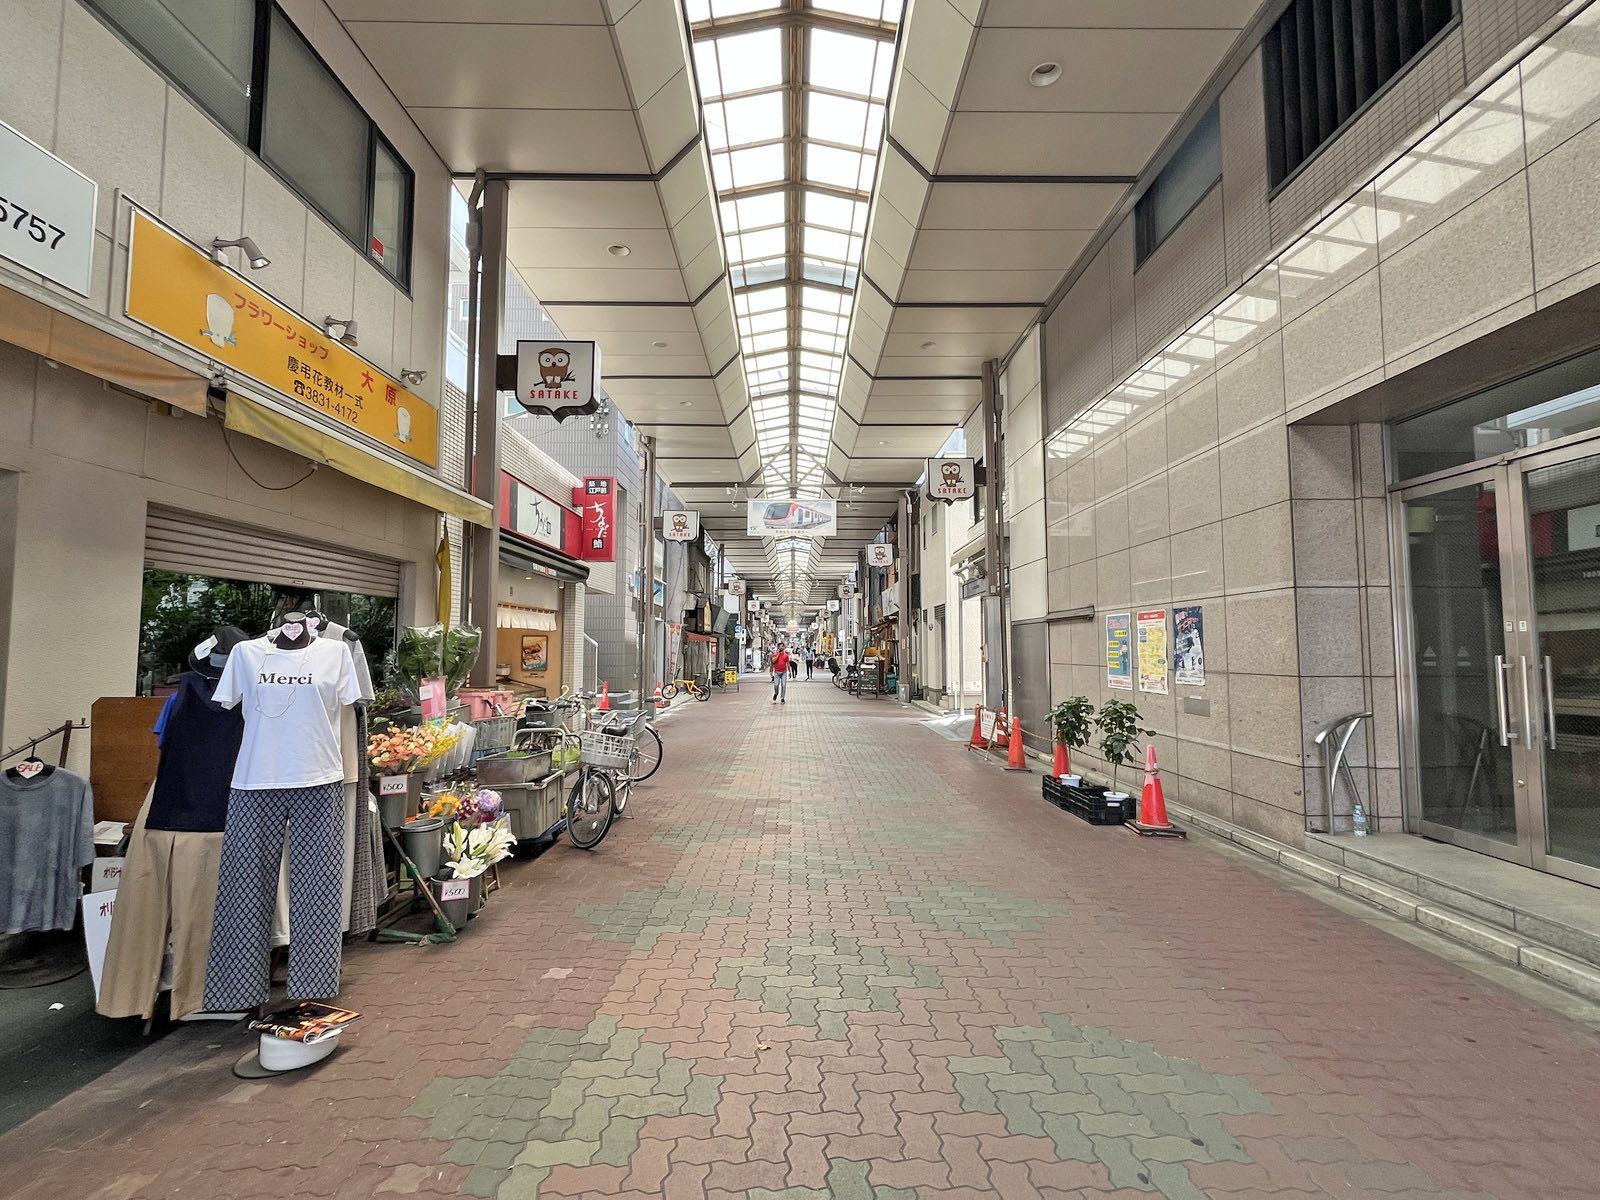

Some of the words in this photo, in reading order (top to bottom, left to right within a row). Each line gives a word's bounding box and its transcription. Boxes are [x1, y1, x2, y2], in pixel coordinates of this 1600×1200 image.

[234, 292, 329, 360] フラワーショップ
[361, 370, 399, 407] 大原
[287, 355, 364, 410] 慶弔花教材一式
[530, 389, 578, 399] SATAKE
[258, 673, 313, 685] Merci
[17, 763, 42, 773] SALE
